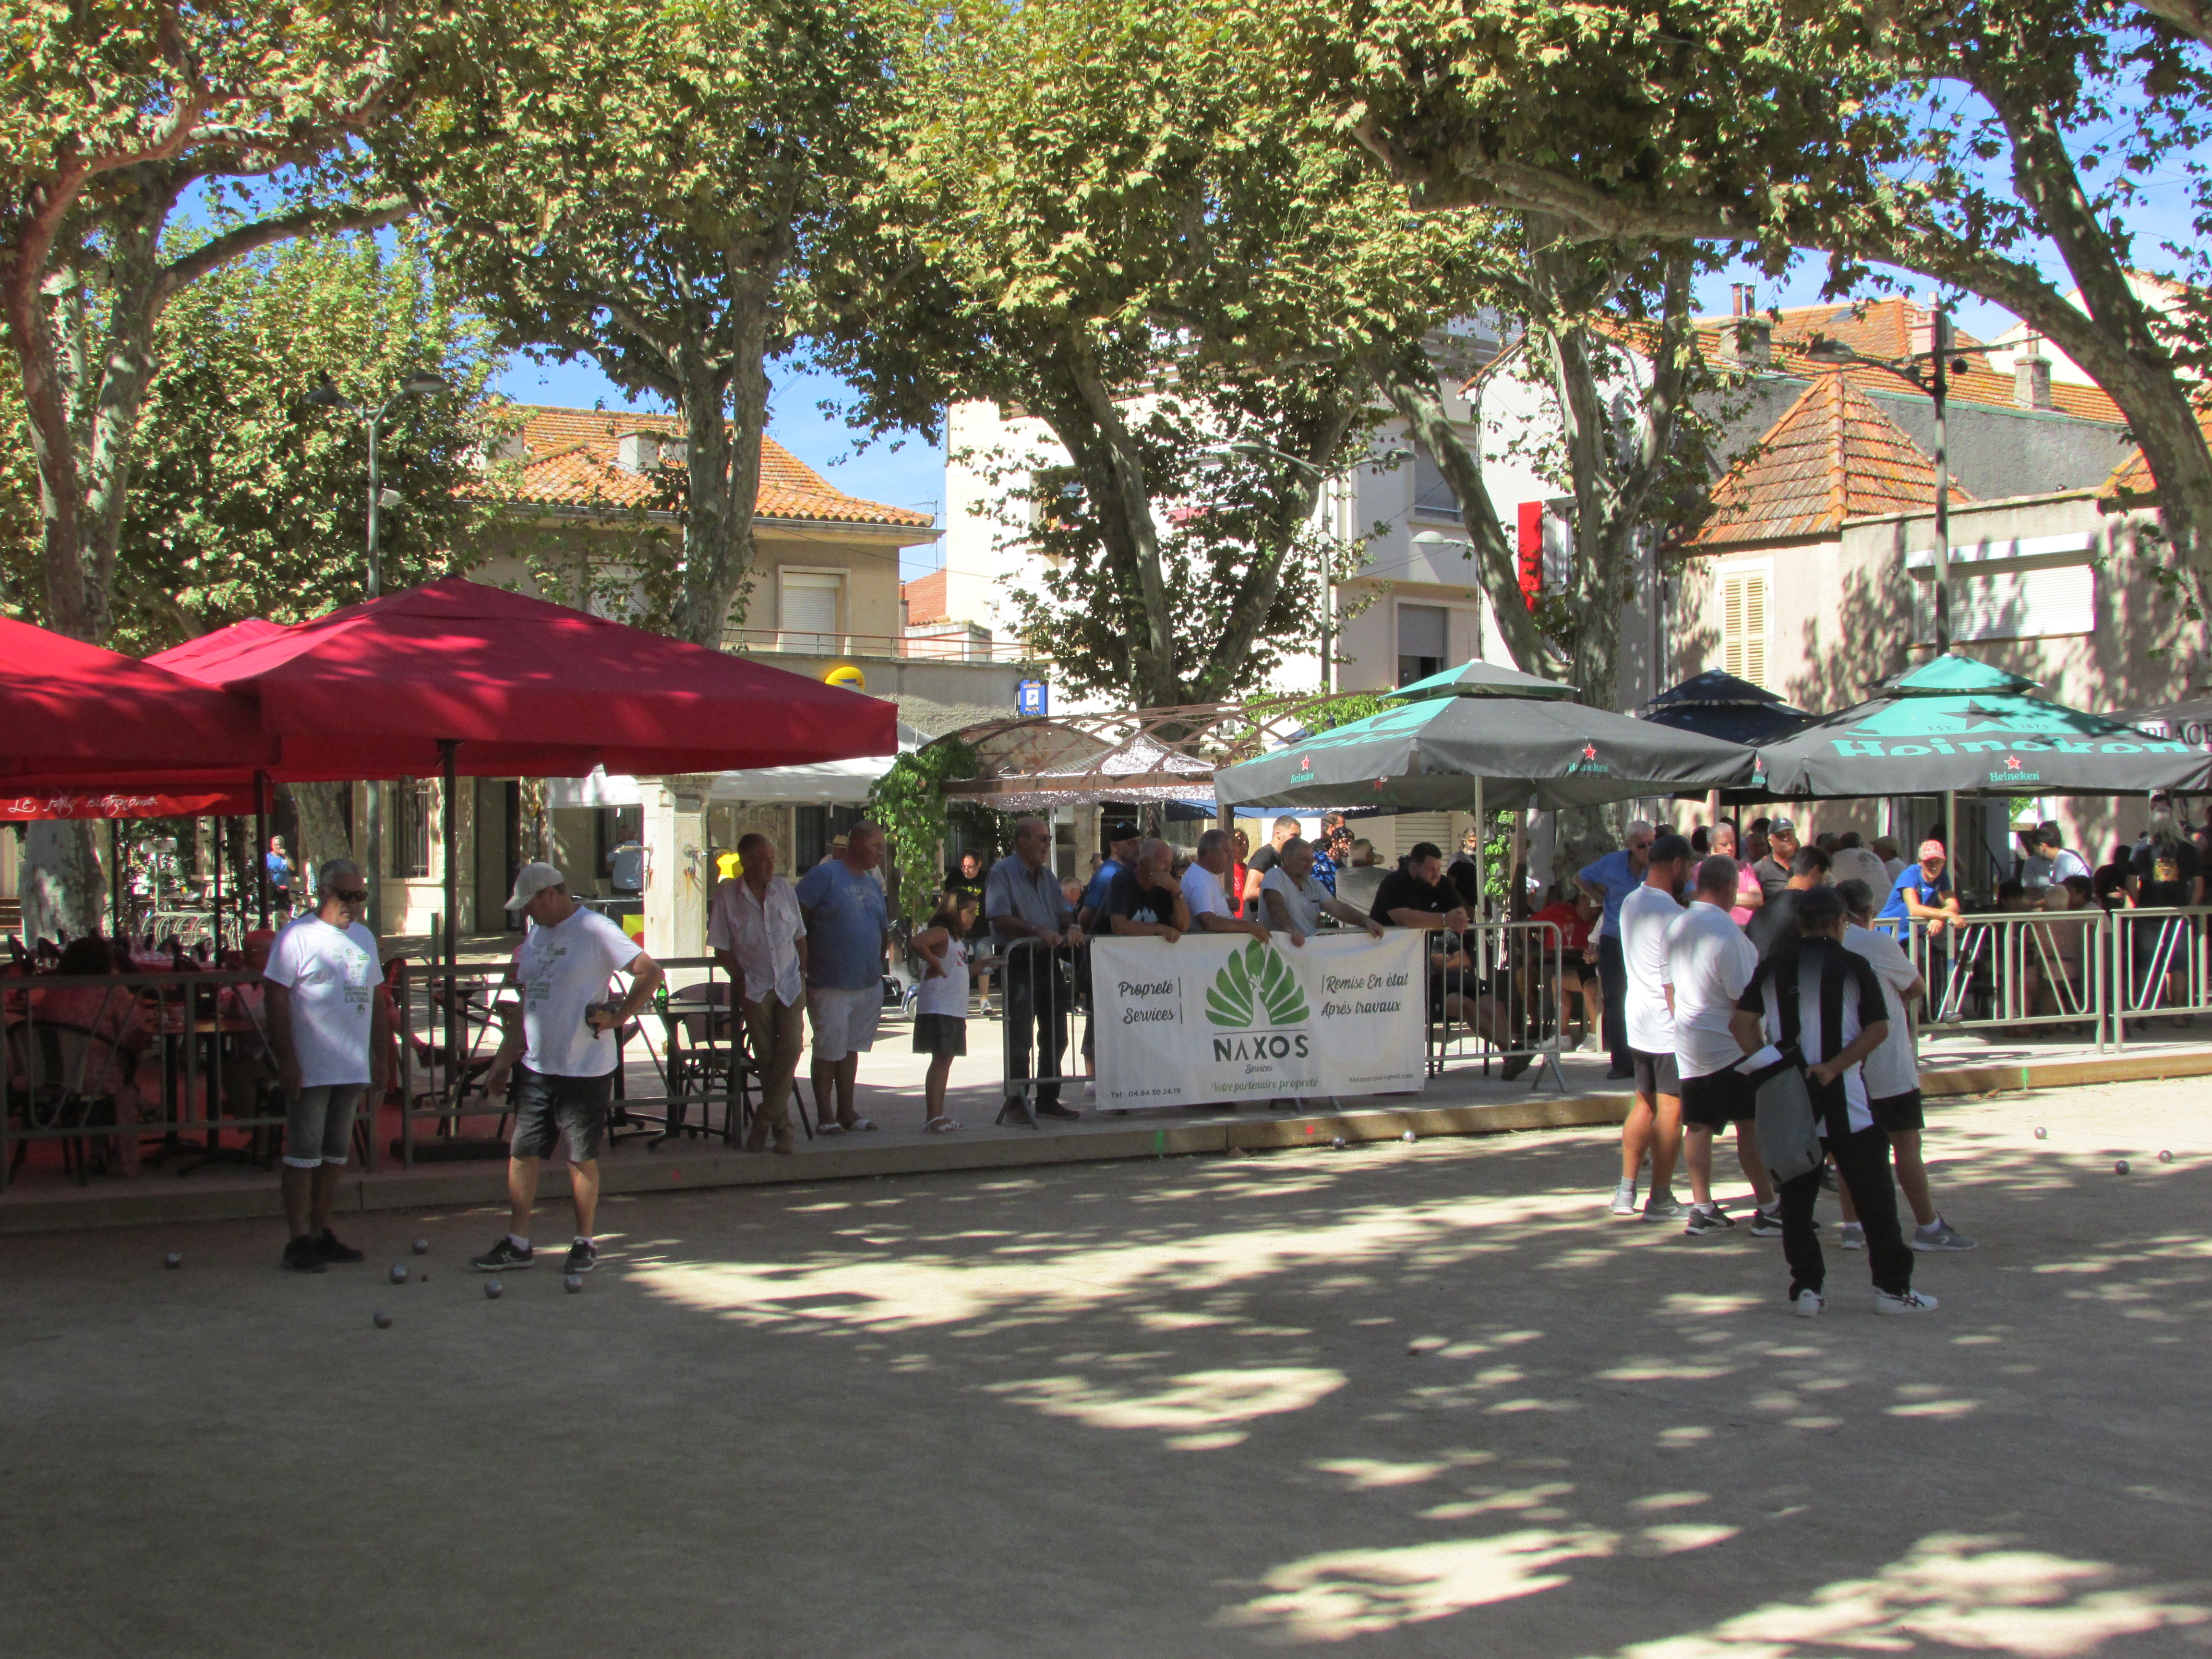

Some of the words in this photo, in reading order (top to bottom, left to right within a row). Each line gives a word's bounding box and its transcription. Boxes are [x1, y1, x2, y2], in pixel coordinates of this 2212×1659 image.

[1568, 762, 1609, 773] Hineken
[1989, 771, 2040, 782] Heineken
[1118, 979, 1175, 999] Propreté
[1326, 975, 1365, 994] Remise
[1367, 974, 1383, 990] En
[1386, 972, 1409, 987] état
[1123, 1007, 1176, 1024] Services
[1321, 1000, 1352, 1019] Après
[1355, 1000, 1401, 1014] travaux
[1213, 1034, 1309, 1062] NAXOS
[1245, 1063, 1273, 1074] Services
[1212, 1082, 1233, 1093] Votre
[1234, 1079, 1277, 1094] partenaire
[1278, 1076, 1319, 1091] propreté
